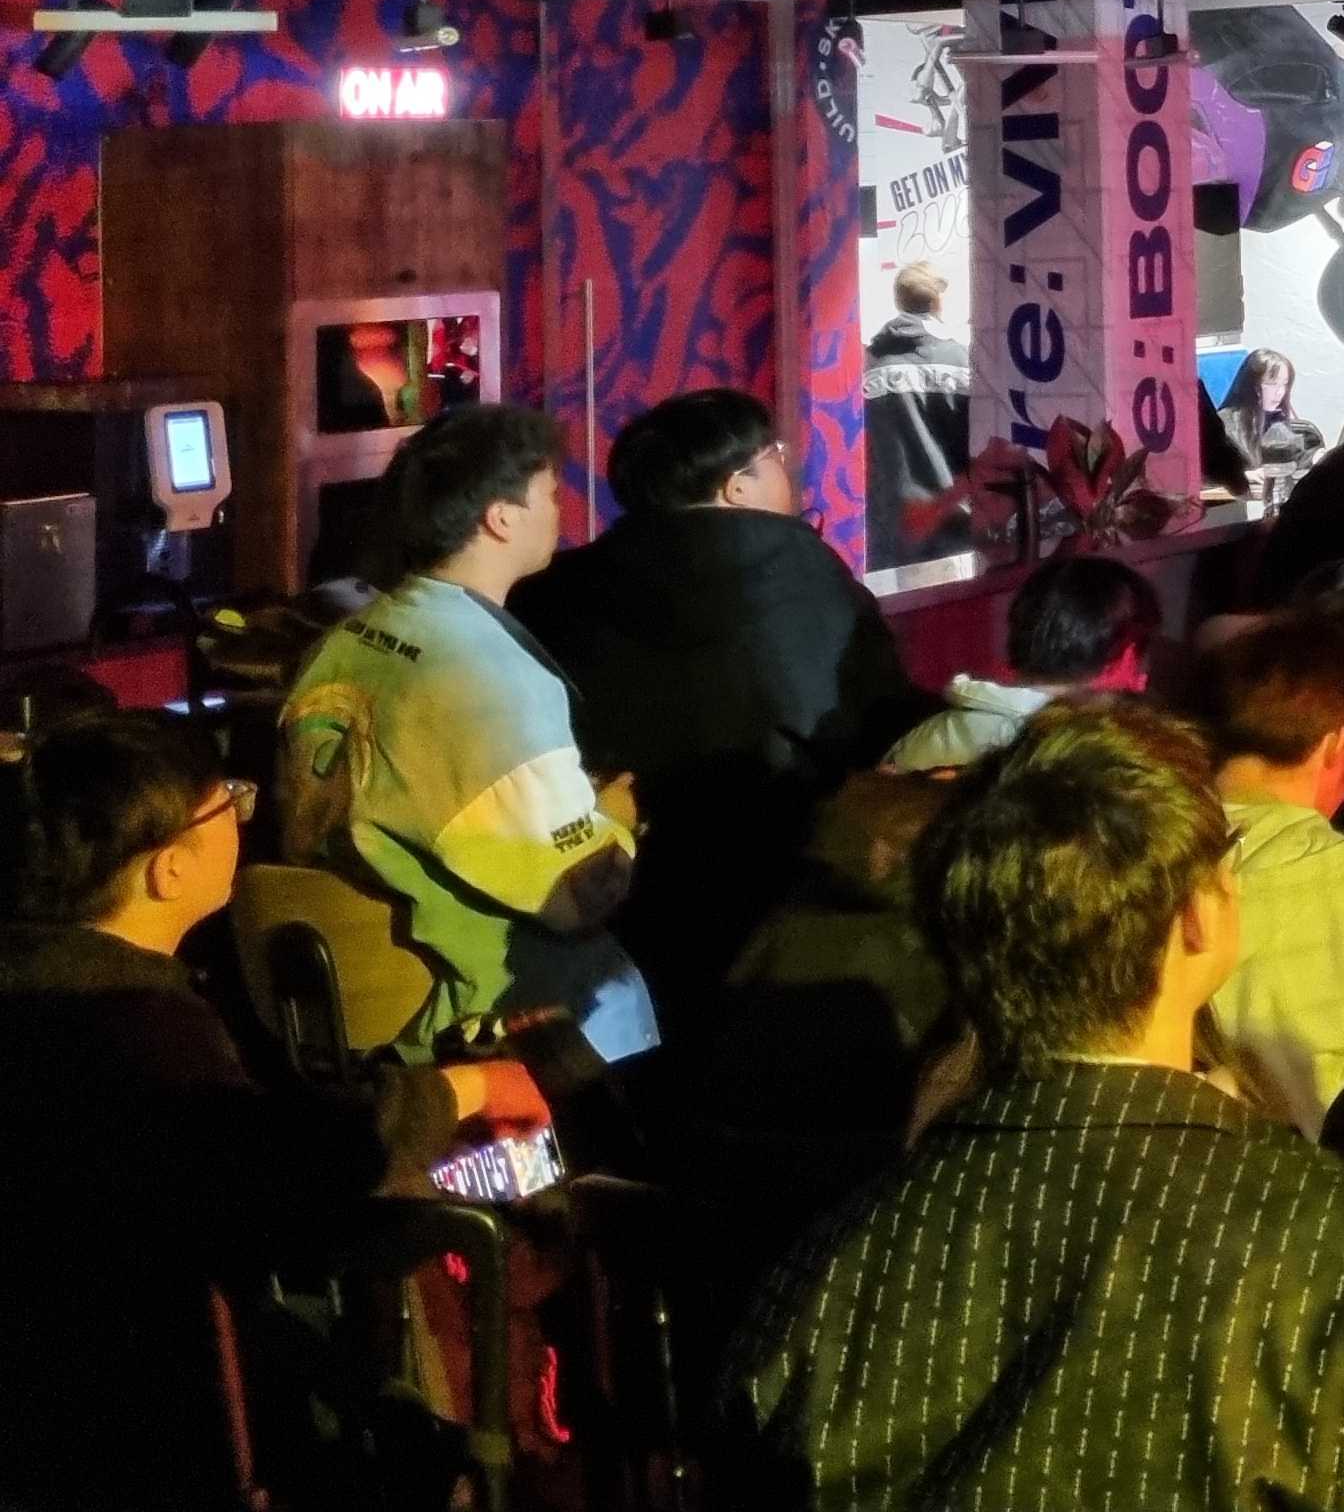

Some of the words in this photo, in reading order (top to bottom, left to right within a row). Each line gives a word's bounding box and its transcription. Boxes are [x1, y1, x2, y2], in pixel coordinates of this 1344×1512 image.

[343, 67, 393, 117] ON
[394, 68, 446, 117] AIR
[889, 172, 923, 212] GET
[922, 161, 951, 199] ON
